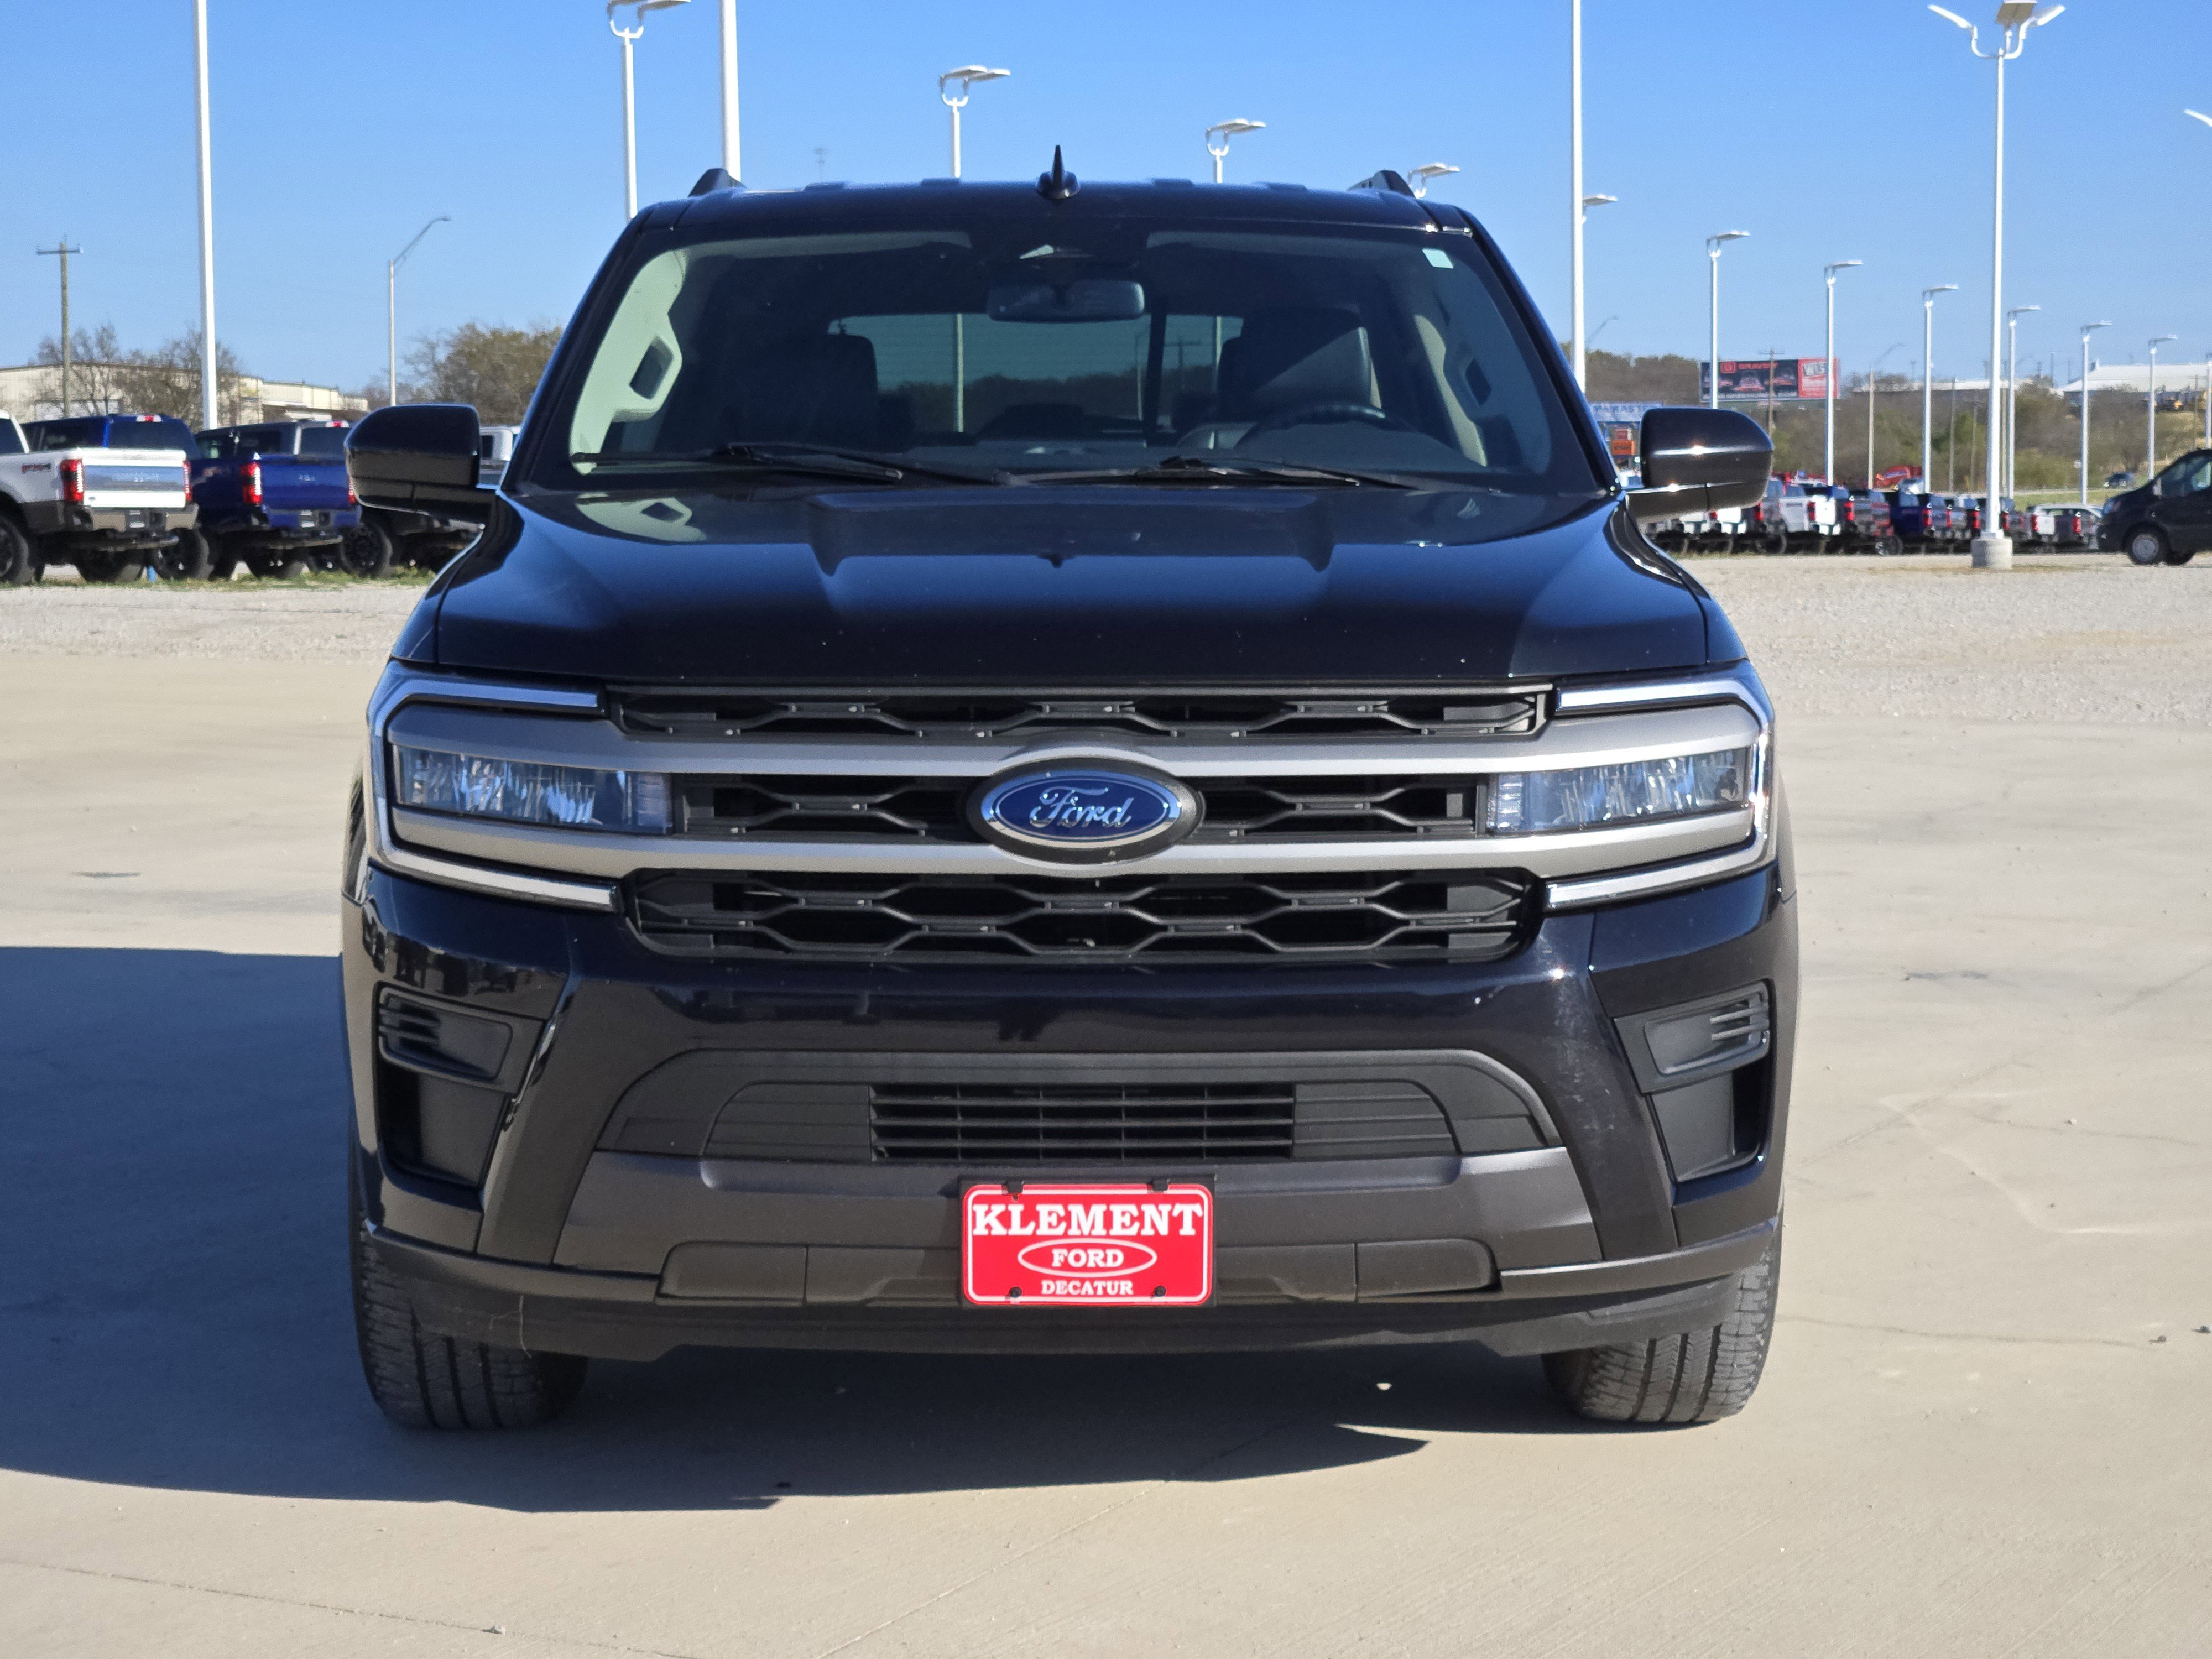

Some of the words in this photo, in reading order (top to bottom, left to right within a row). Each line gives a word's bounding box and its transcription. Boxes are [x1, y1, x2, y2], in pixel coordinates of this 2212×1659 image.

[1030, 786, 1135, 828] Ford
[972, 1203, 1203, 1236] KLEMENT
[1051, 1248, 1124, 1268] FORD
[1041, 1280, 1133, 1295] DECATUR
